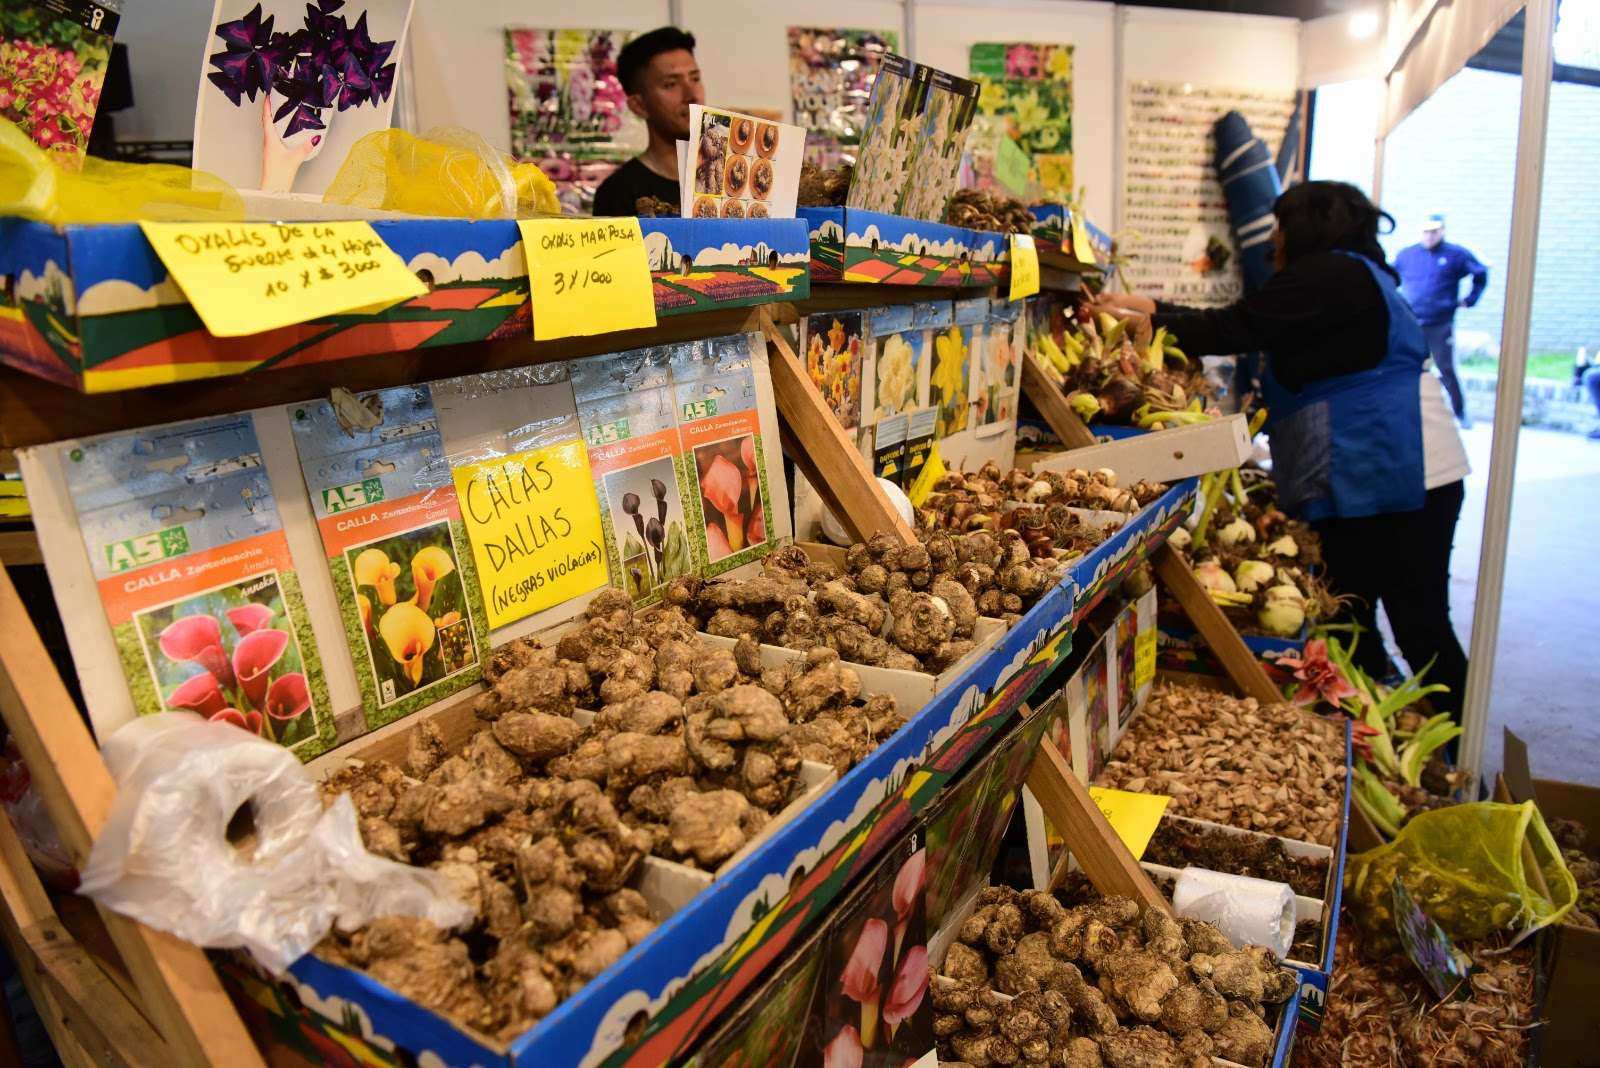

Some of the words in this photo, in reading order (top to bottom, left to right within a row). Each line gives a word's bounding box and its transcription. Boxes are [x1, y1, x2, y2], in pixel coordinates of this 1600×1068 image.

[175, 230, 267, 254] OXALIS
[690, 423, 714, 435] CALLA
[467, 461, 553, 524] CALAS
[336, 513, 379, 532] CALLA
[484, 507, 571, 573] DALLAS
[124, 568, 181, 593] CALLA
